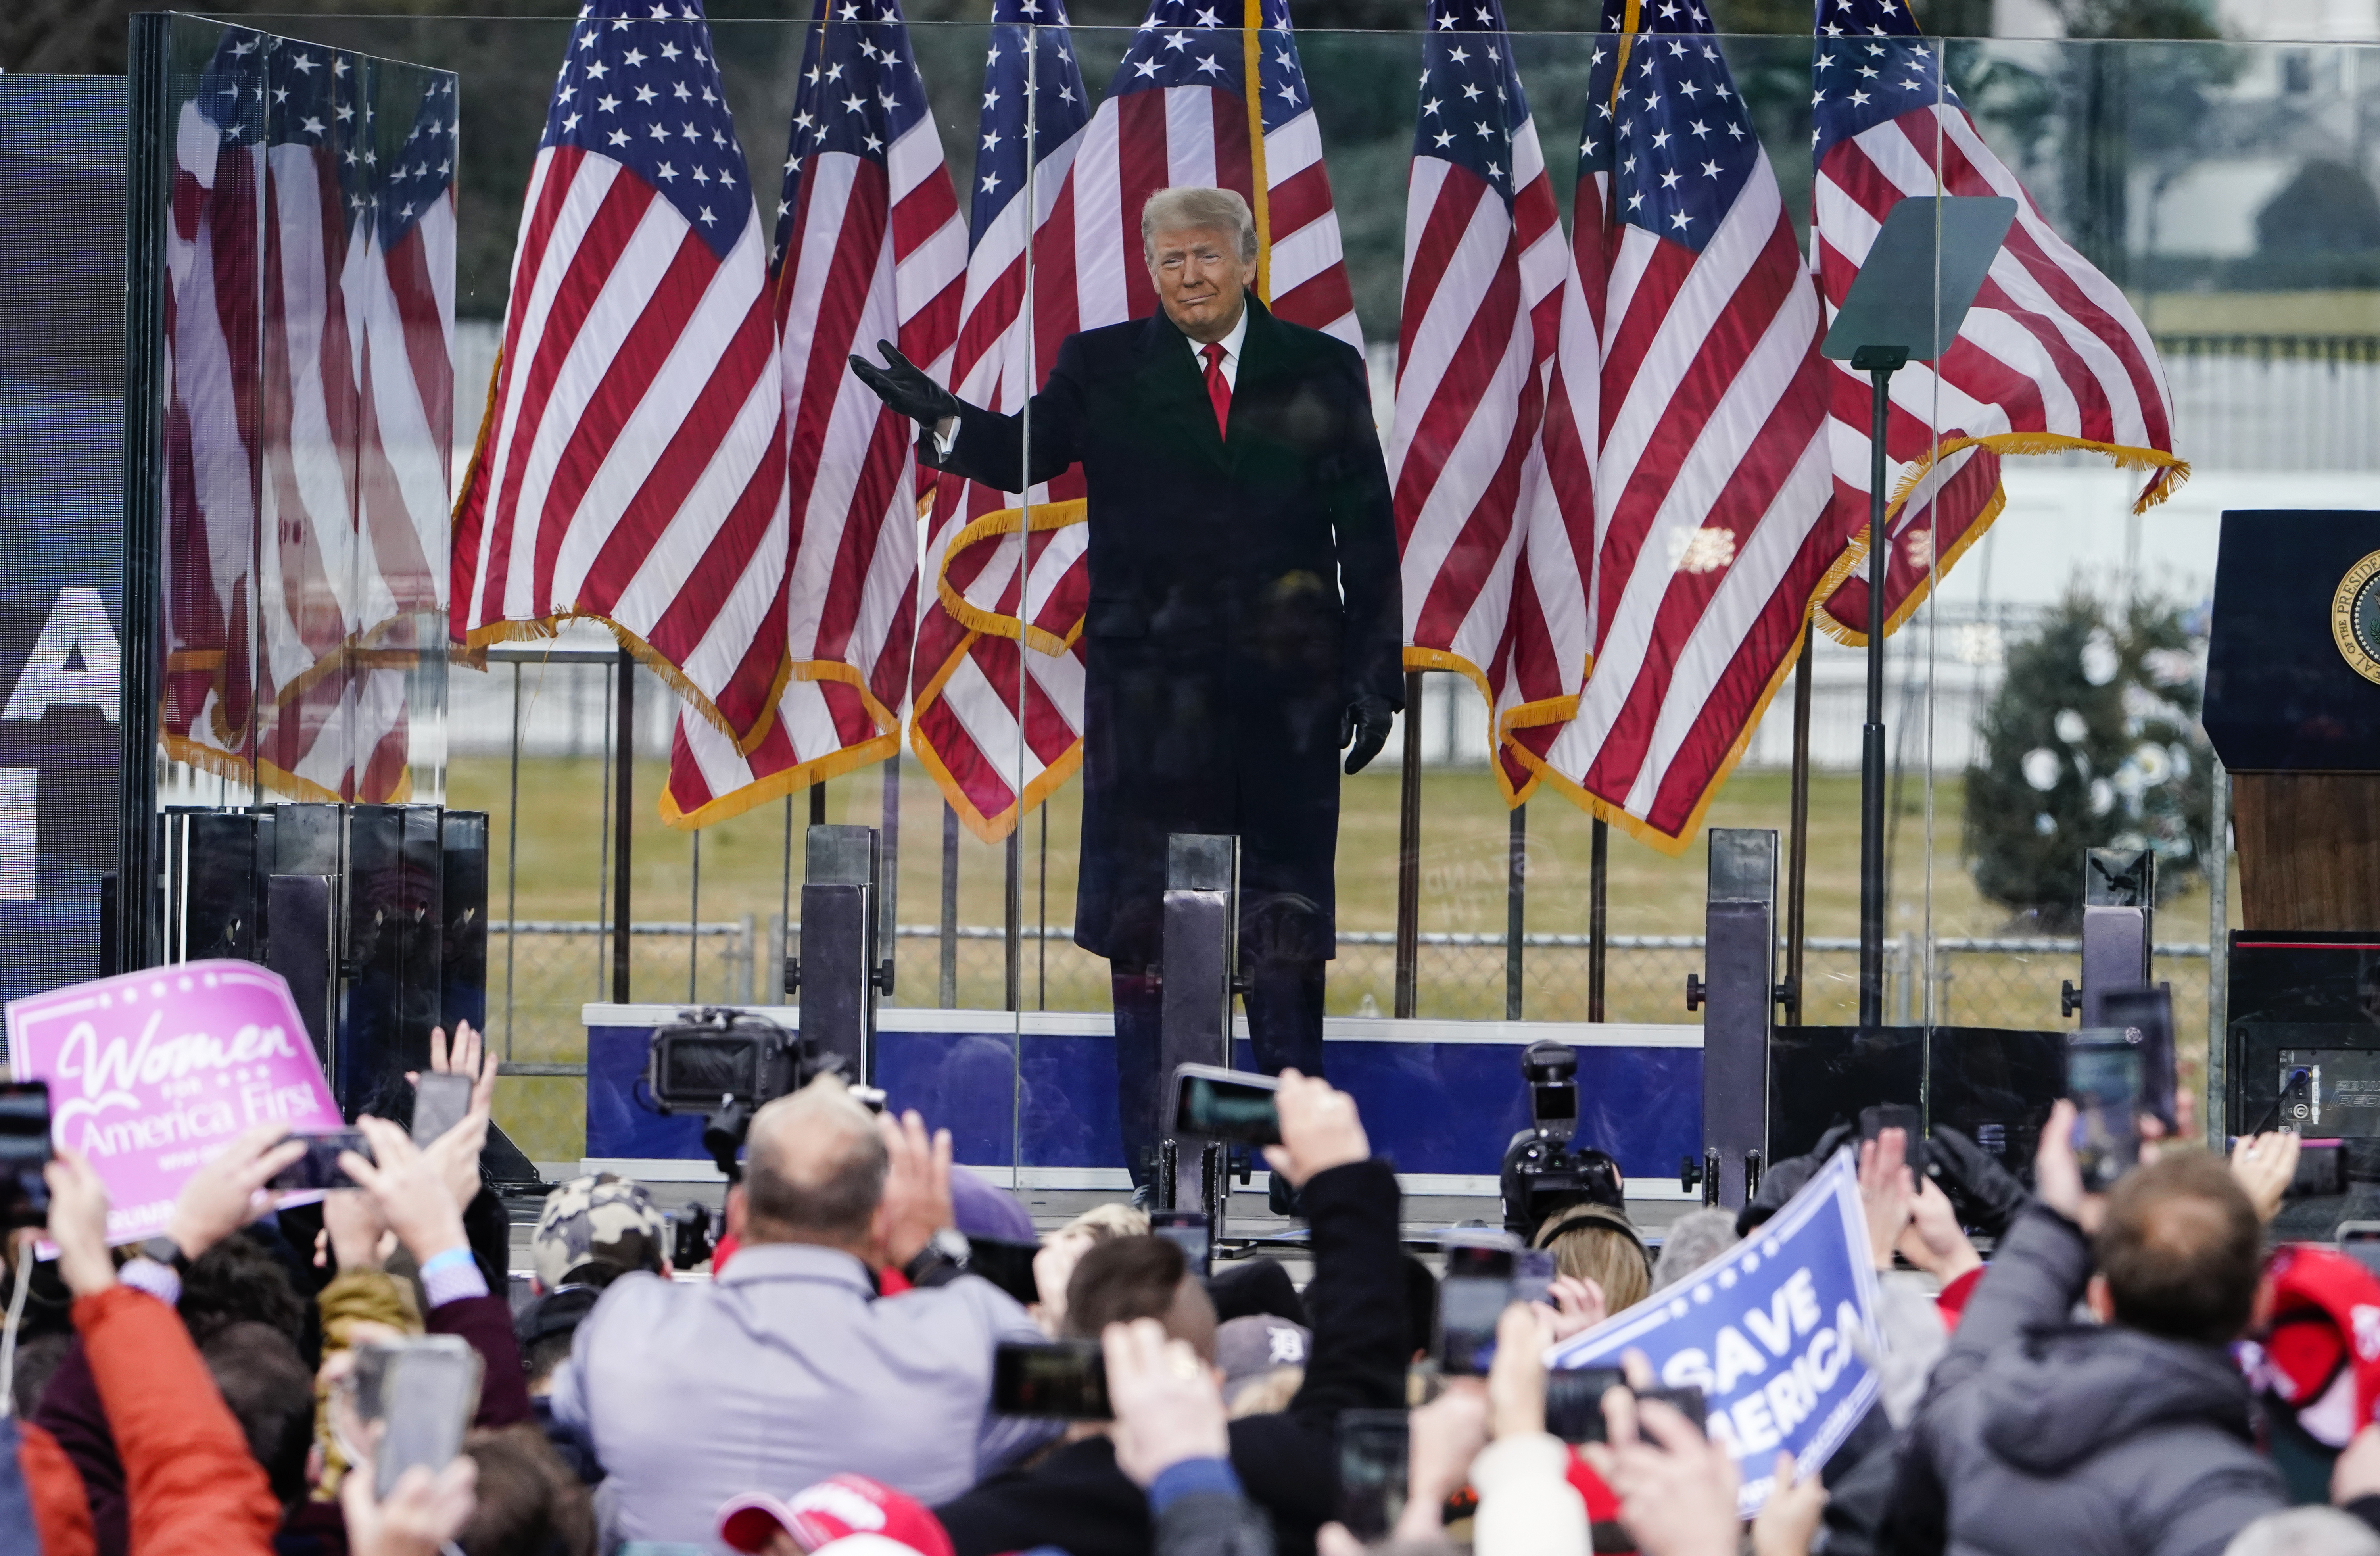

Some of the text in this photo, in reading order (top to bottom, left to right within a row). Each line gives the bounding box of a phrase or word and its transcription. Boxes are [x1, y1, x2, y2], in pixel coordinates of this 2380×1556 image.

[2338, 555, 2380, 614] PRESIDE
[2339, 620, 2350, 640] THE
[2344, 642, 2356, 654] OF
[56, 1009, 297, 1098] Women
[51, 1090, 236, 1158] America
[240, 1080, 321, 1126] First
[1662, 1266, 1822, 1396] SAVE
